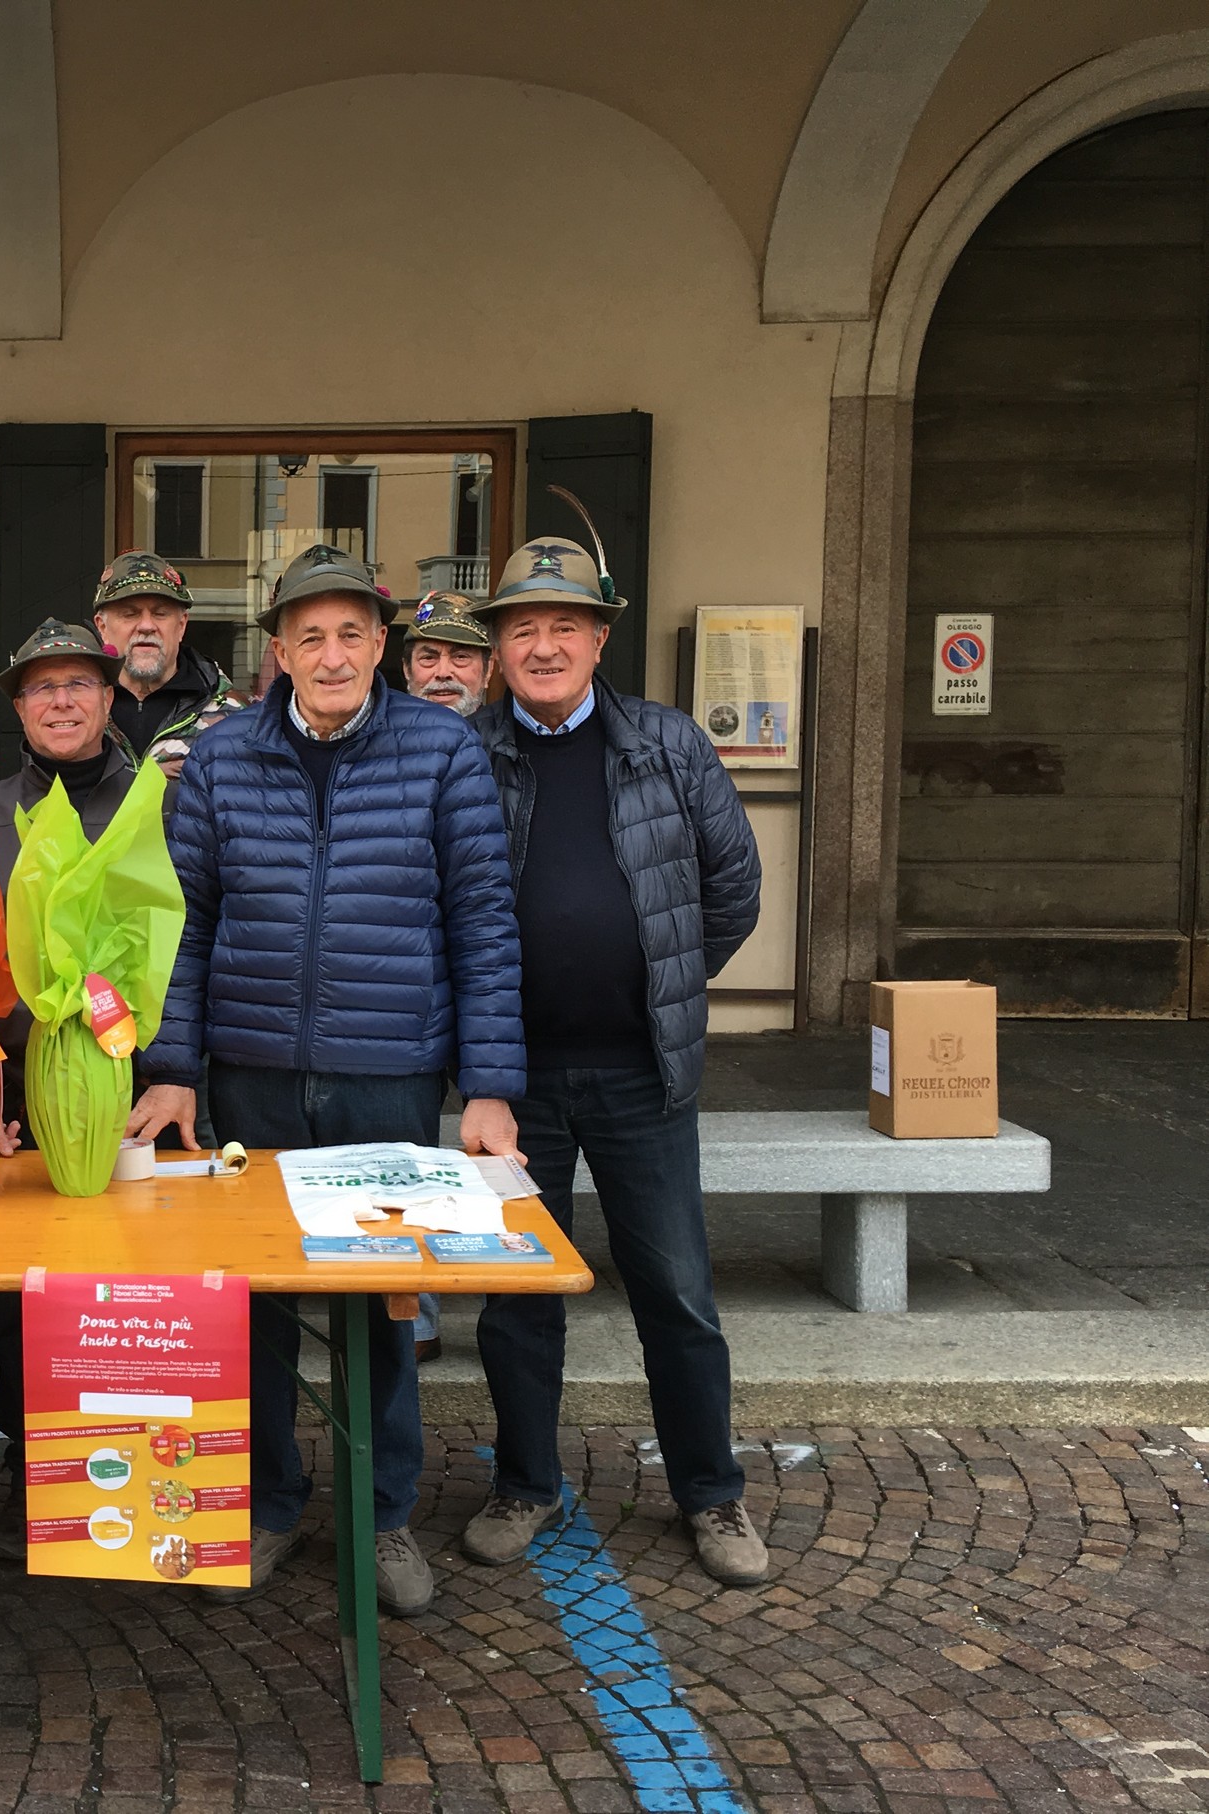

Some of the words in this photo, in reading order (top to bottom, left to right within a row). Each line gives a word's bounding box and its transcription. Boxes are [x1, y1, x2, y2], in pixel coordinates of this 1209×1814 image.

[946, 678, 978, 690] passo
[938, 692, 986, 704] carrabile
[911, 1090, 982, 1099] DISTILLERIA
[78, 1314, 120, 1330] Dona
[122, 1316, 152, 1329] vita
[154, 1318, 167, 1330] in
[170, 1316, 194, 1337] più.
[79, 1333, 118, 1347] Anche
[120, 1337, 133, 1348] a
[136, 1334, 194, 1352] Pasqua.
